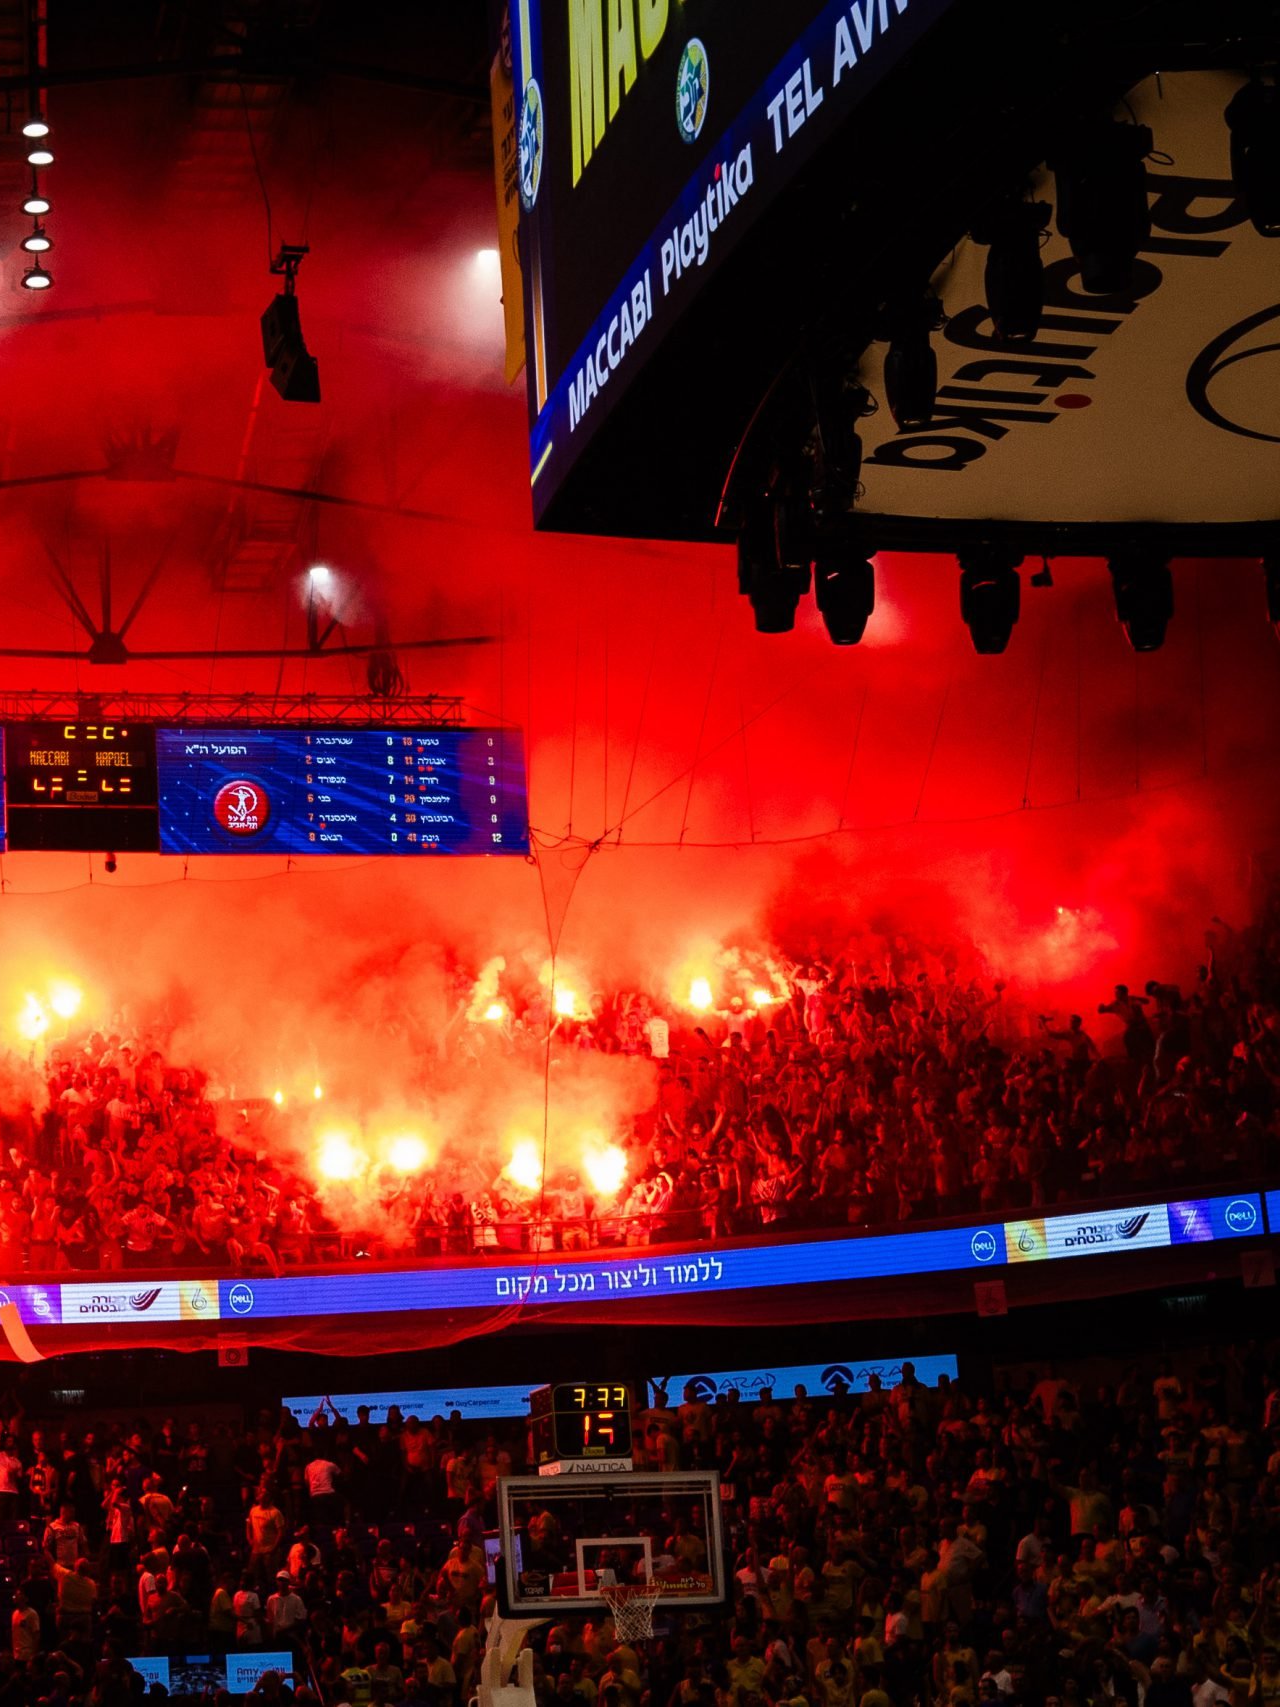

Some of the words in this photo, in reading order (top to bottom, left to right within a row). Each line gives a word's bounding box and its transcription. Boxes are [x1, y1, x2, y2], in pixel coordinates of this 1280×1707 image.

[568, 268, 652, 432] MACCABI
[660, 142, 754, 295] Playtika
[767, 58, 824, 154] TEL
[832, 0, 909, 87] AVI
[305, 736, 311, 745] 1
[387, 736, 393, 746] 0
[212, 743, 247, 755] הפועל
[30, 751, 70, 766] MACCABI
[388, 775, 394, 784] 7
[390, 813, 397, 822] 4
[492, 833, 502, 843] 12
[1180, 1208, 1197, 1235] 7
[1229, 1210, 1255, 1223] DELL
[974, 1240, 994, 1252] DELL
[1018, 1228, 1034, 1252] 6
[602, 1263, 657, 1290] וליצור
[664, 1257, 723, 1284] ללמוד
[496, 1275, 548, 1300] מקום
[554, 1269, 595, 1292] מכל
[33, 1292, 50, 1316] 5
[191, 1288, 208, 1311] 6
[230, 1294, 252, 1304] DELL
[856, 1365, 904, 1379] ARA
[719, 1373, 776, 1390] ARAD
[576, 1462, 627, 1473] NAUTICA
